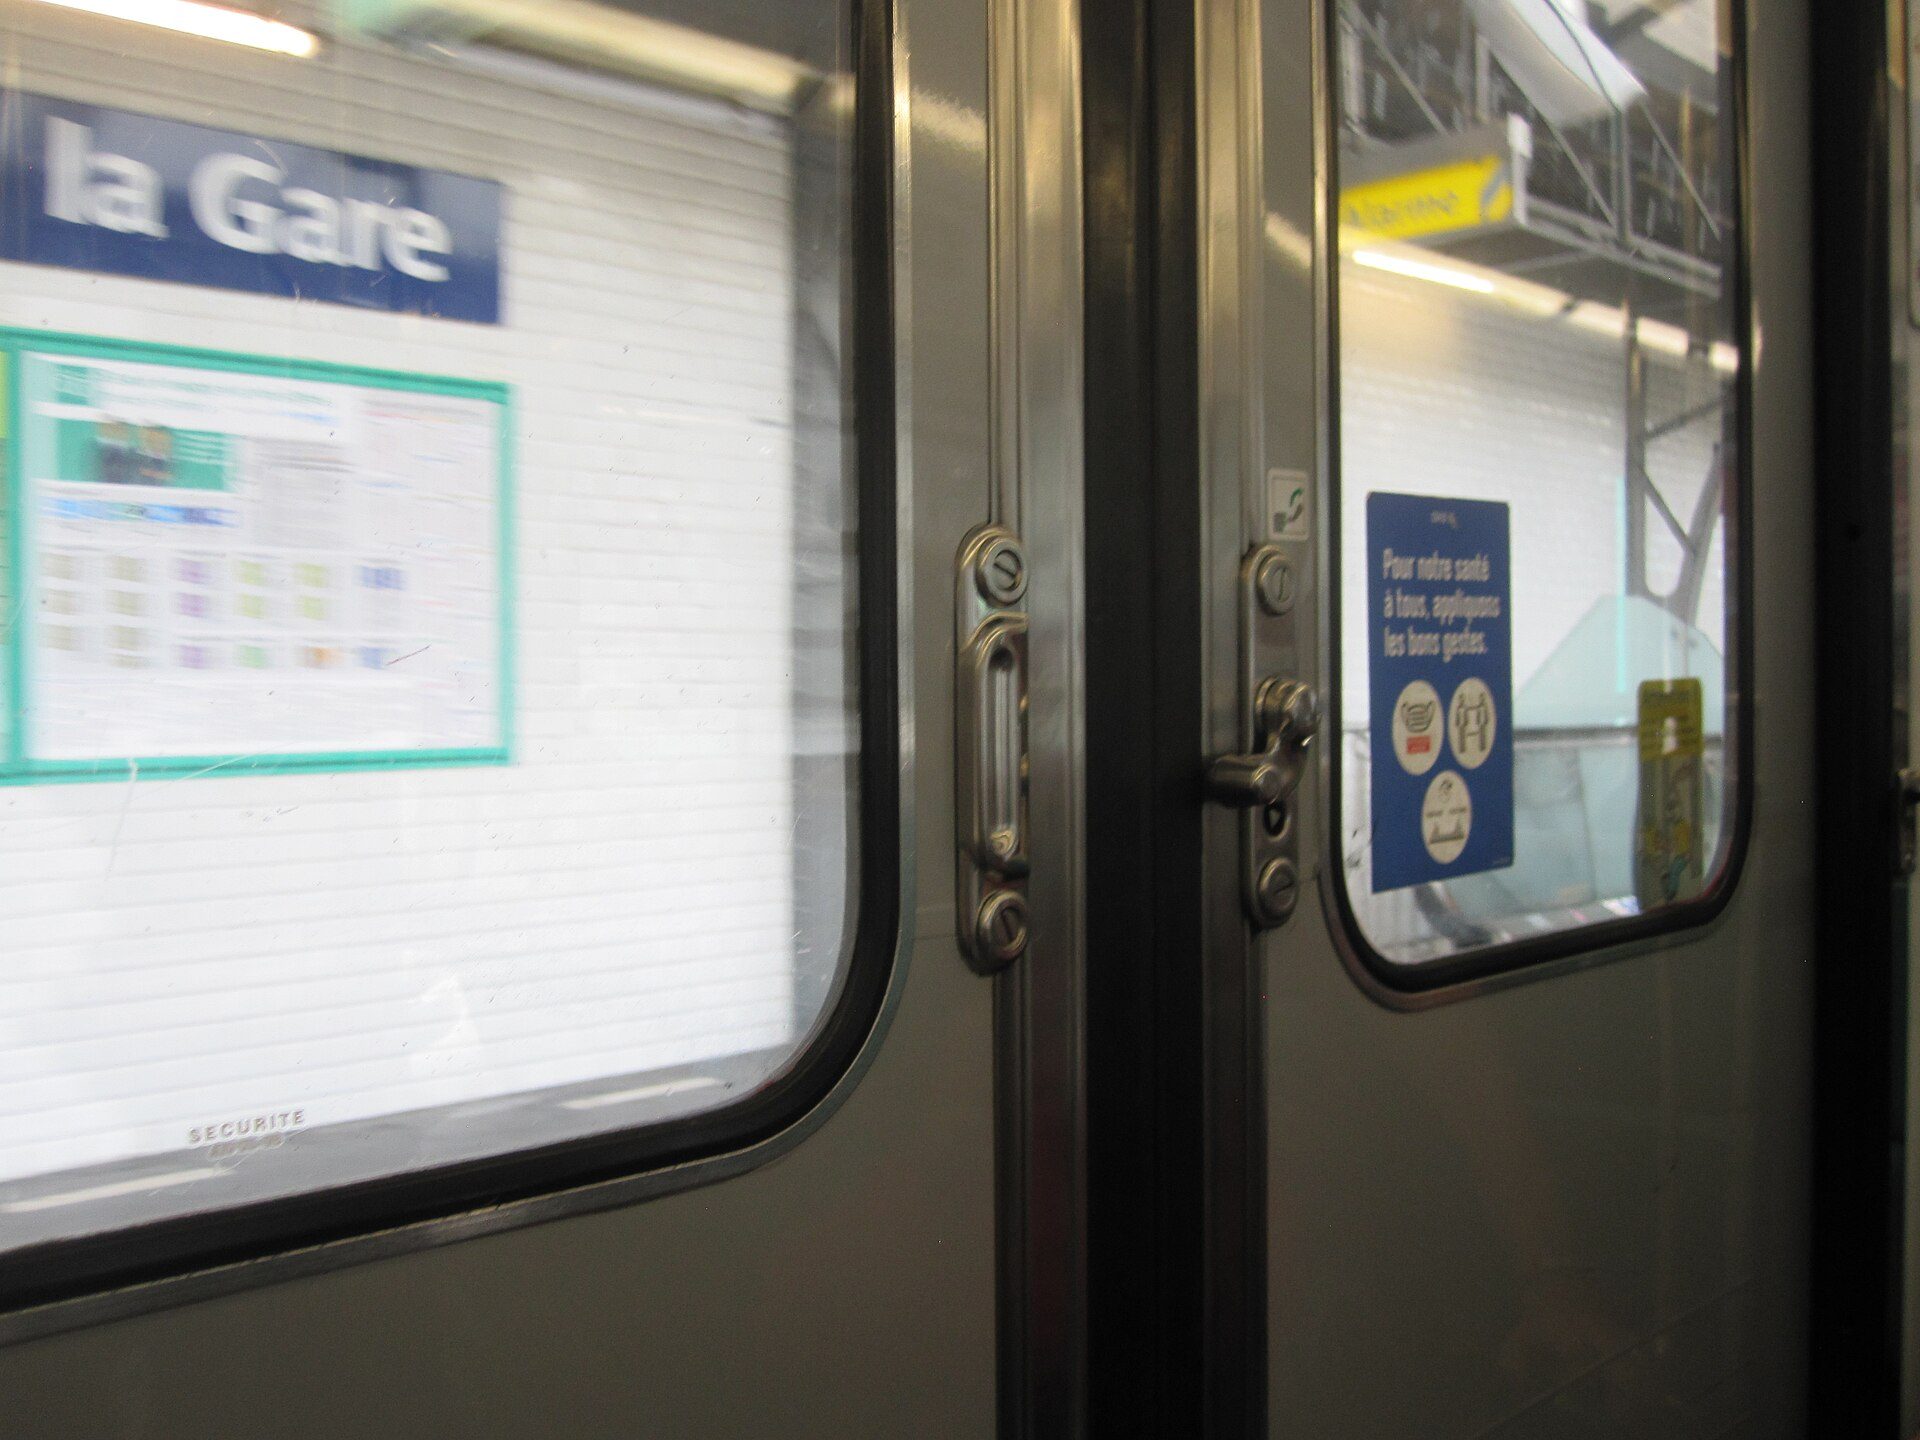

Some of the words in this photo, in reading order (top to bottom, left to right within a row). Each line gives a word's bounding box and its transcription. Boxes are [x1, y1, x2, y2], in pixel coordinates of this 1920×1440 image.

[44, 115, 170, 240] la
[190, 152, 453, 283] Gare
[1382, 547, 1415, 580] Pour
[1417, 550, 1453, 582] notre
[1455, 552, 1490, 582] santé
[1384, 626, 1406, 657] les
[1408, 626, 1440, 657] bons
[188, 1108, 305, 1145] SECURITE
